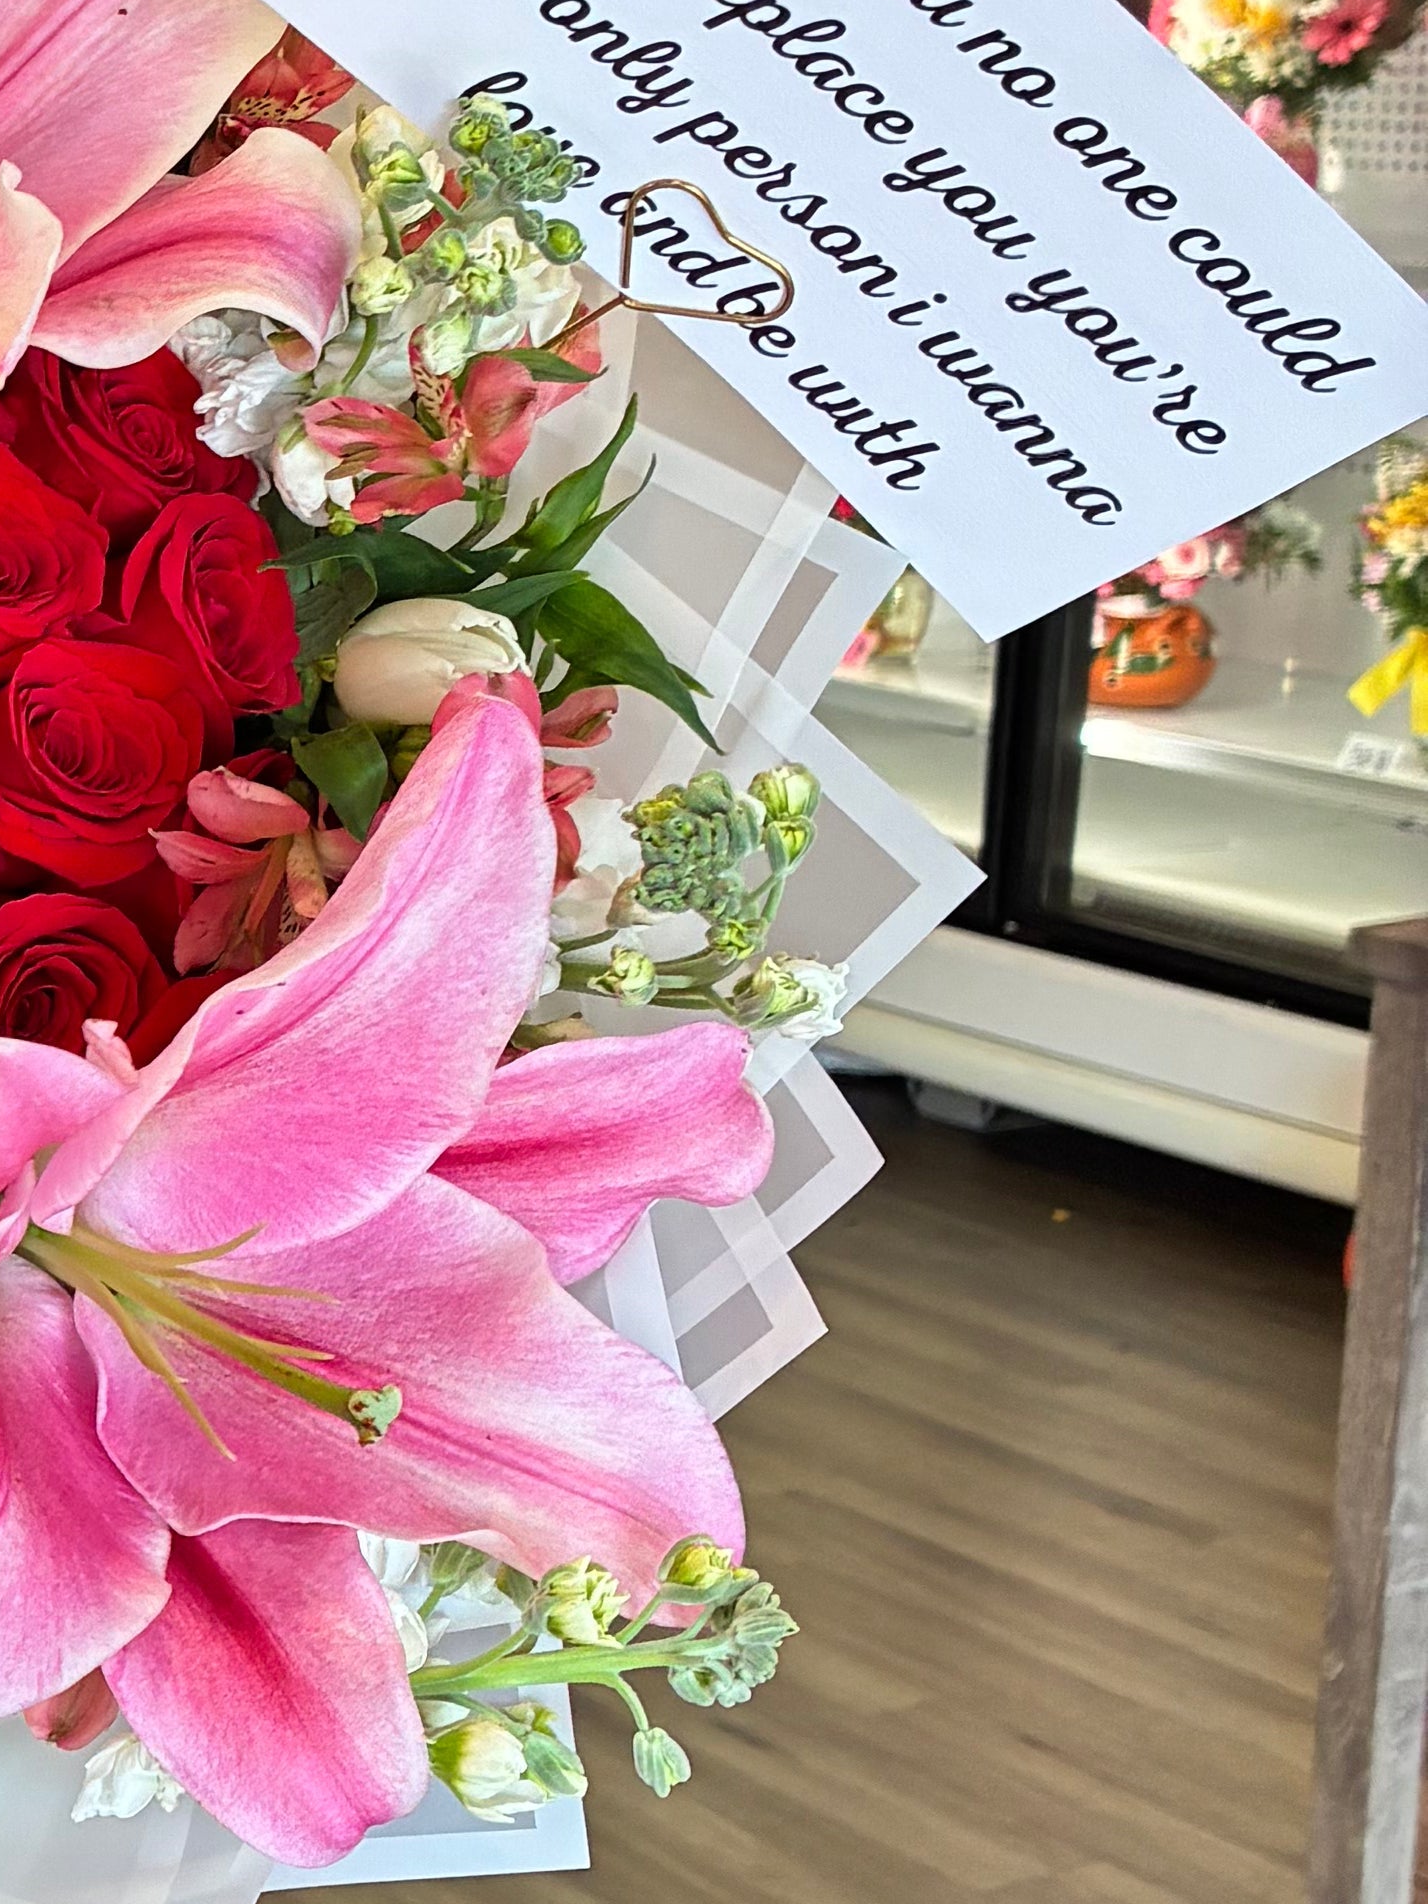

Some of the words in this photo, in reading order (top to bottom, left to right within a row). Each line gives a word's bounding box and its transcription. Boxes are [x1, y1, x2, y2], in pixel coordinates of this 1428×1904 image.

[600, 191, 750, 288] and
[716, 282, 797, 358] be
[788, 364, 941, 491] with
[652, 111, 898, 298] person
[918, 330, 1123, 526] wanna
[882, 147, 1036, 260] you
[1005, 268, 1227, 455] you're
[956, 29, 1056, 108] no
[1053, 116, 1178, 221] one
[1168, 228, 1377, 393] could
